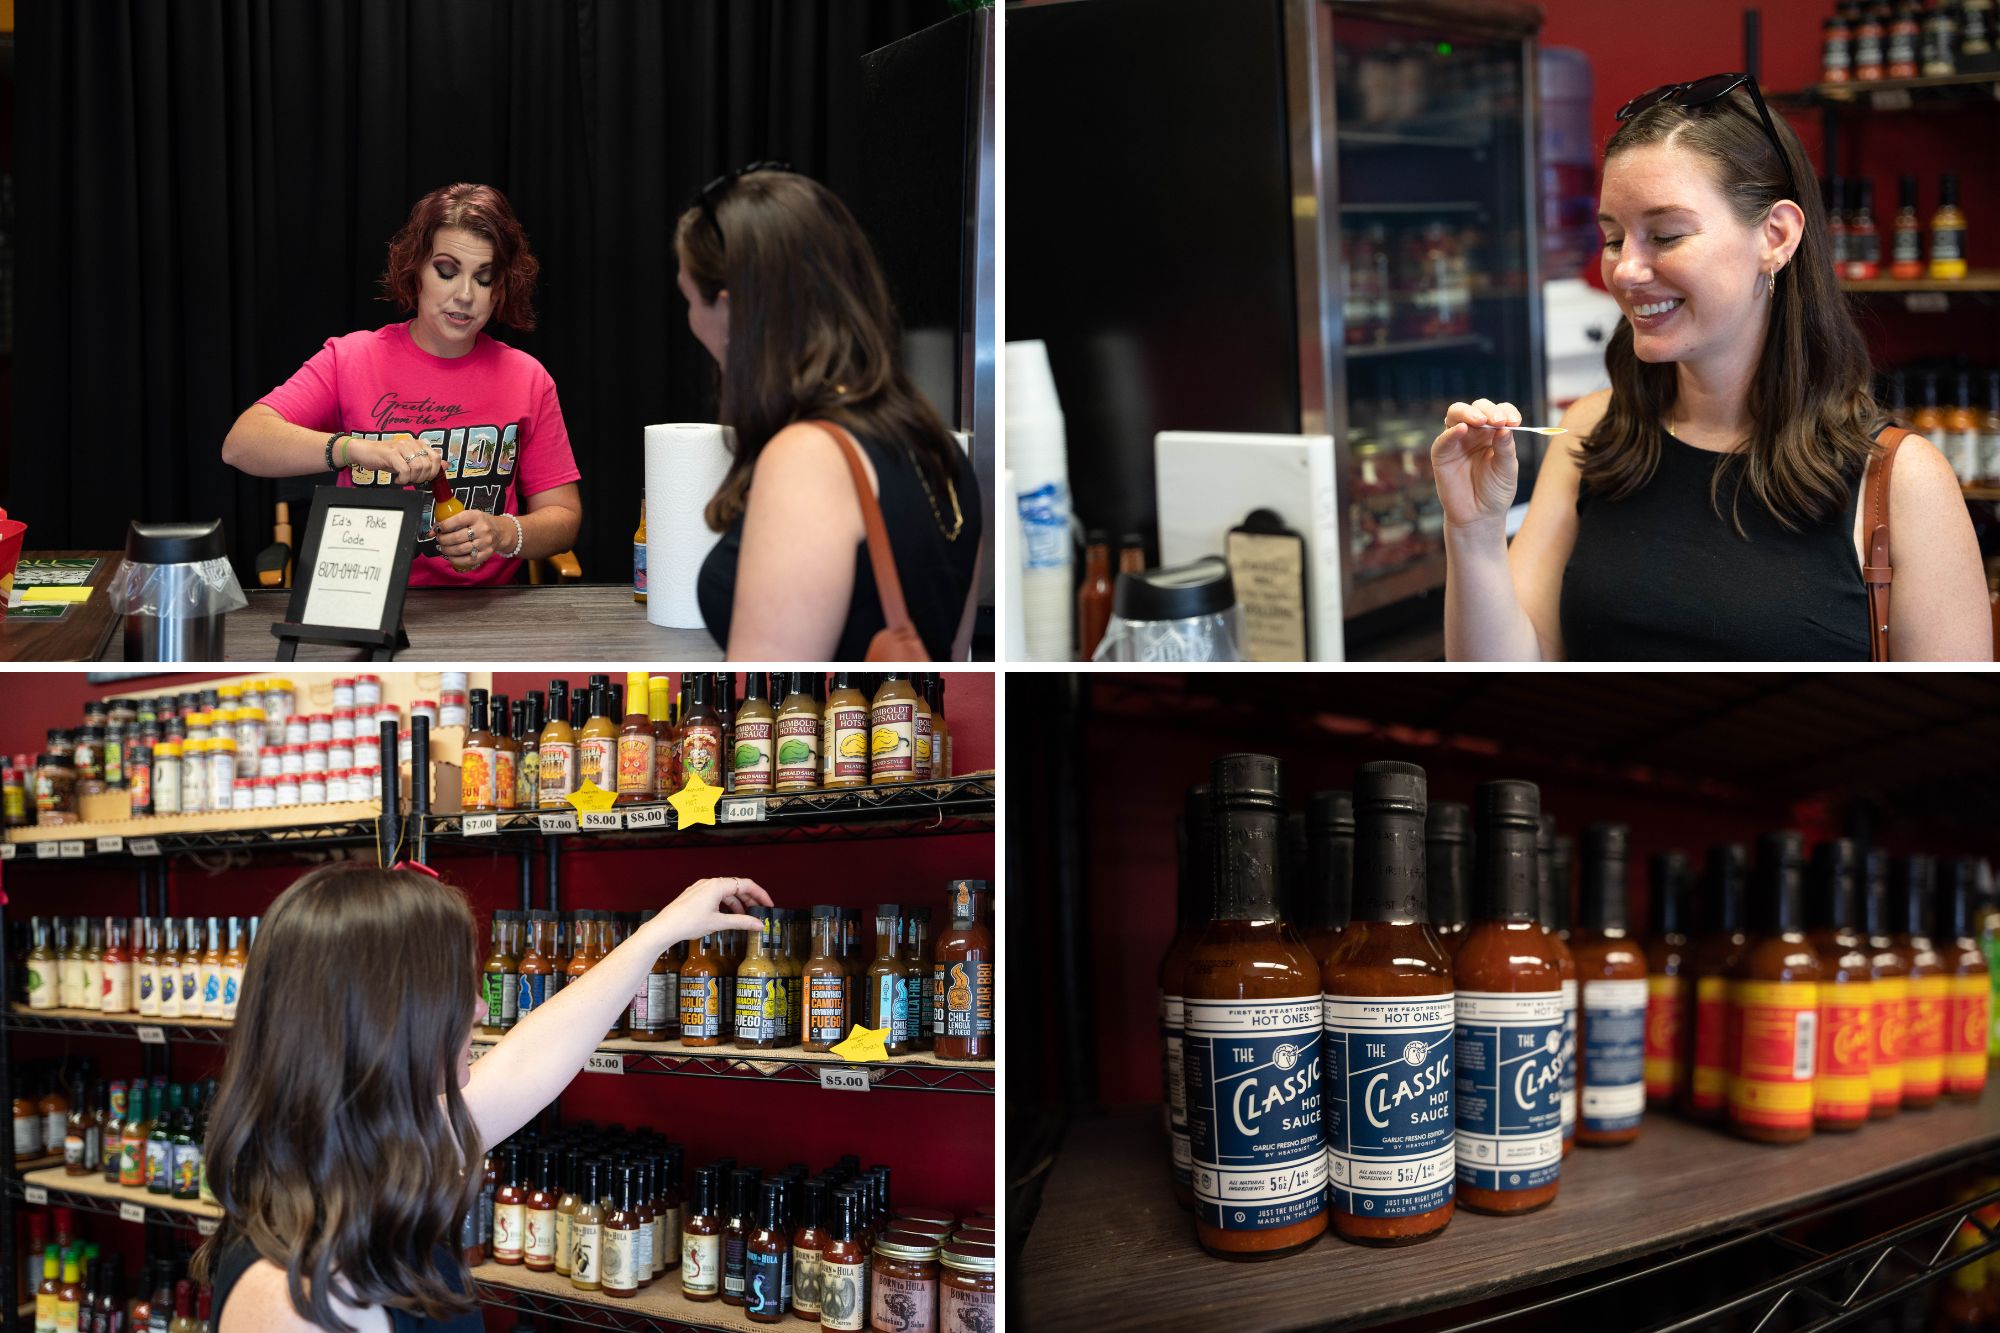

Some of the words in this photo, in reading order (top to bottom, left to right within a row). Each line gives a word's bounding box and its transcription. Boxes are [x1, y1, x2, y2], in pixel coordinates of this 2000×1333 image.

[371, 392, 472, 427] Greetings
[381, 413, 411, 430] from
[412, 414, 436, 425] the
[331, 514, 352, 528] Ed's
[342, 531, 364, 546] Code
[779, 720, 817, 729] HUMBOLDT
[586, 815, 616, 825] $8.00
[630, 810, 662, 823] $8.00
[466, 819, 492, 830] $7.00
[542, 819, 571, 830] $7.00
[976, 963, 991, 985] BBQ
[811, 998, 841, 1008] CAMOTE
[976, 987, 991, 1019] ALTAR
[811, 1015, 841, 1028] FUEGO
[948, 1013, 970, 1022] CHILE
[1252, 1016, 1279, 1026] HOT
[1384, 1013, 1410, 1023] HOT
[948, 1022, 970, 1030] LENGUA
[1517, 1034, 1535, 1048] THE
[1232, 1048, 1254, 1063] THE
[1366, 1043, 1386, 1058] THE
[589, 1058, 619, 1069] $5.00
[826, 1075, 864, 1087] $5.00
[1232, 1056, 1321, 1136] CLASSIC
[1364, 1054, 1449, 1128] CLASSIC
[1429, 1090, 1448, 1106] HOT
[1301, 1094, 1321, 1111] HOT
[1282, 1110, 1322, 1131] SAUCE
[1410, 1106, 1448, 1124] SAUCE
[1252, 1142, 1276, 1152] GARLIC
[1276, 1139, 1300, 1150] FRESNO
[1300, 1134, 1318, 1145] EDITION
[1382, 1136, 1404, 1144] GARLIC
[1404, 1134, 1427, 1142] FRESNO
[1427, 1128, 1445, 1138] EDITION
[1398, 1168, 1404, 1182] 5
[1406, 1174, 1414, 1182] OZ
[1270, 1177, 1277, 1192] 5
[1258, 1208, 1274, 1218] JUST
[1276, 1206, 1288, 1216] THE
[1288, 1202, 1304, 1213] RIGHT
[1305, 1196, 1318, 1210] SPICE
[1386, 1198, 1400, 1206] JUST
[1414, 1194, 1430, 1204] RIGHT
[1257, 1217, 1280, 1225] MADE
[1283, 1214, 1291, 1222] IN
[1294, 1210, 1307, 1219] THE
[1308, 1205, 1320, 1214] USA
[1384, 1206, 1406, 1214] MADE
[1419, 1202, 1432, 1210] THE
[761, 1254, 778, 1264] HULA
[837, 1266, 854, 1277] HULA
[879, 1274, 896, 1289] BORN
[897, 1282, 903, 1290] to
[905, 1280, 925, 1292] HULA
[951, 1287, 971, 1302] BORN
[972, 1294, 979, 1303] to
